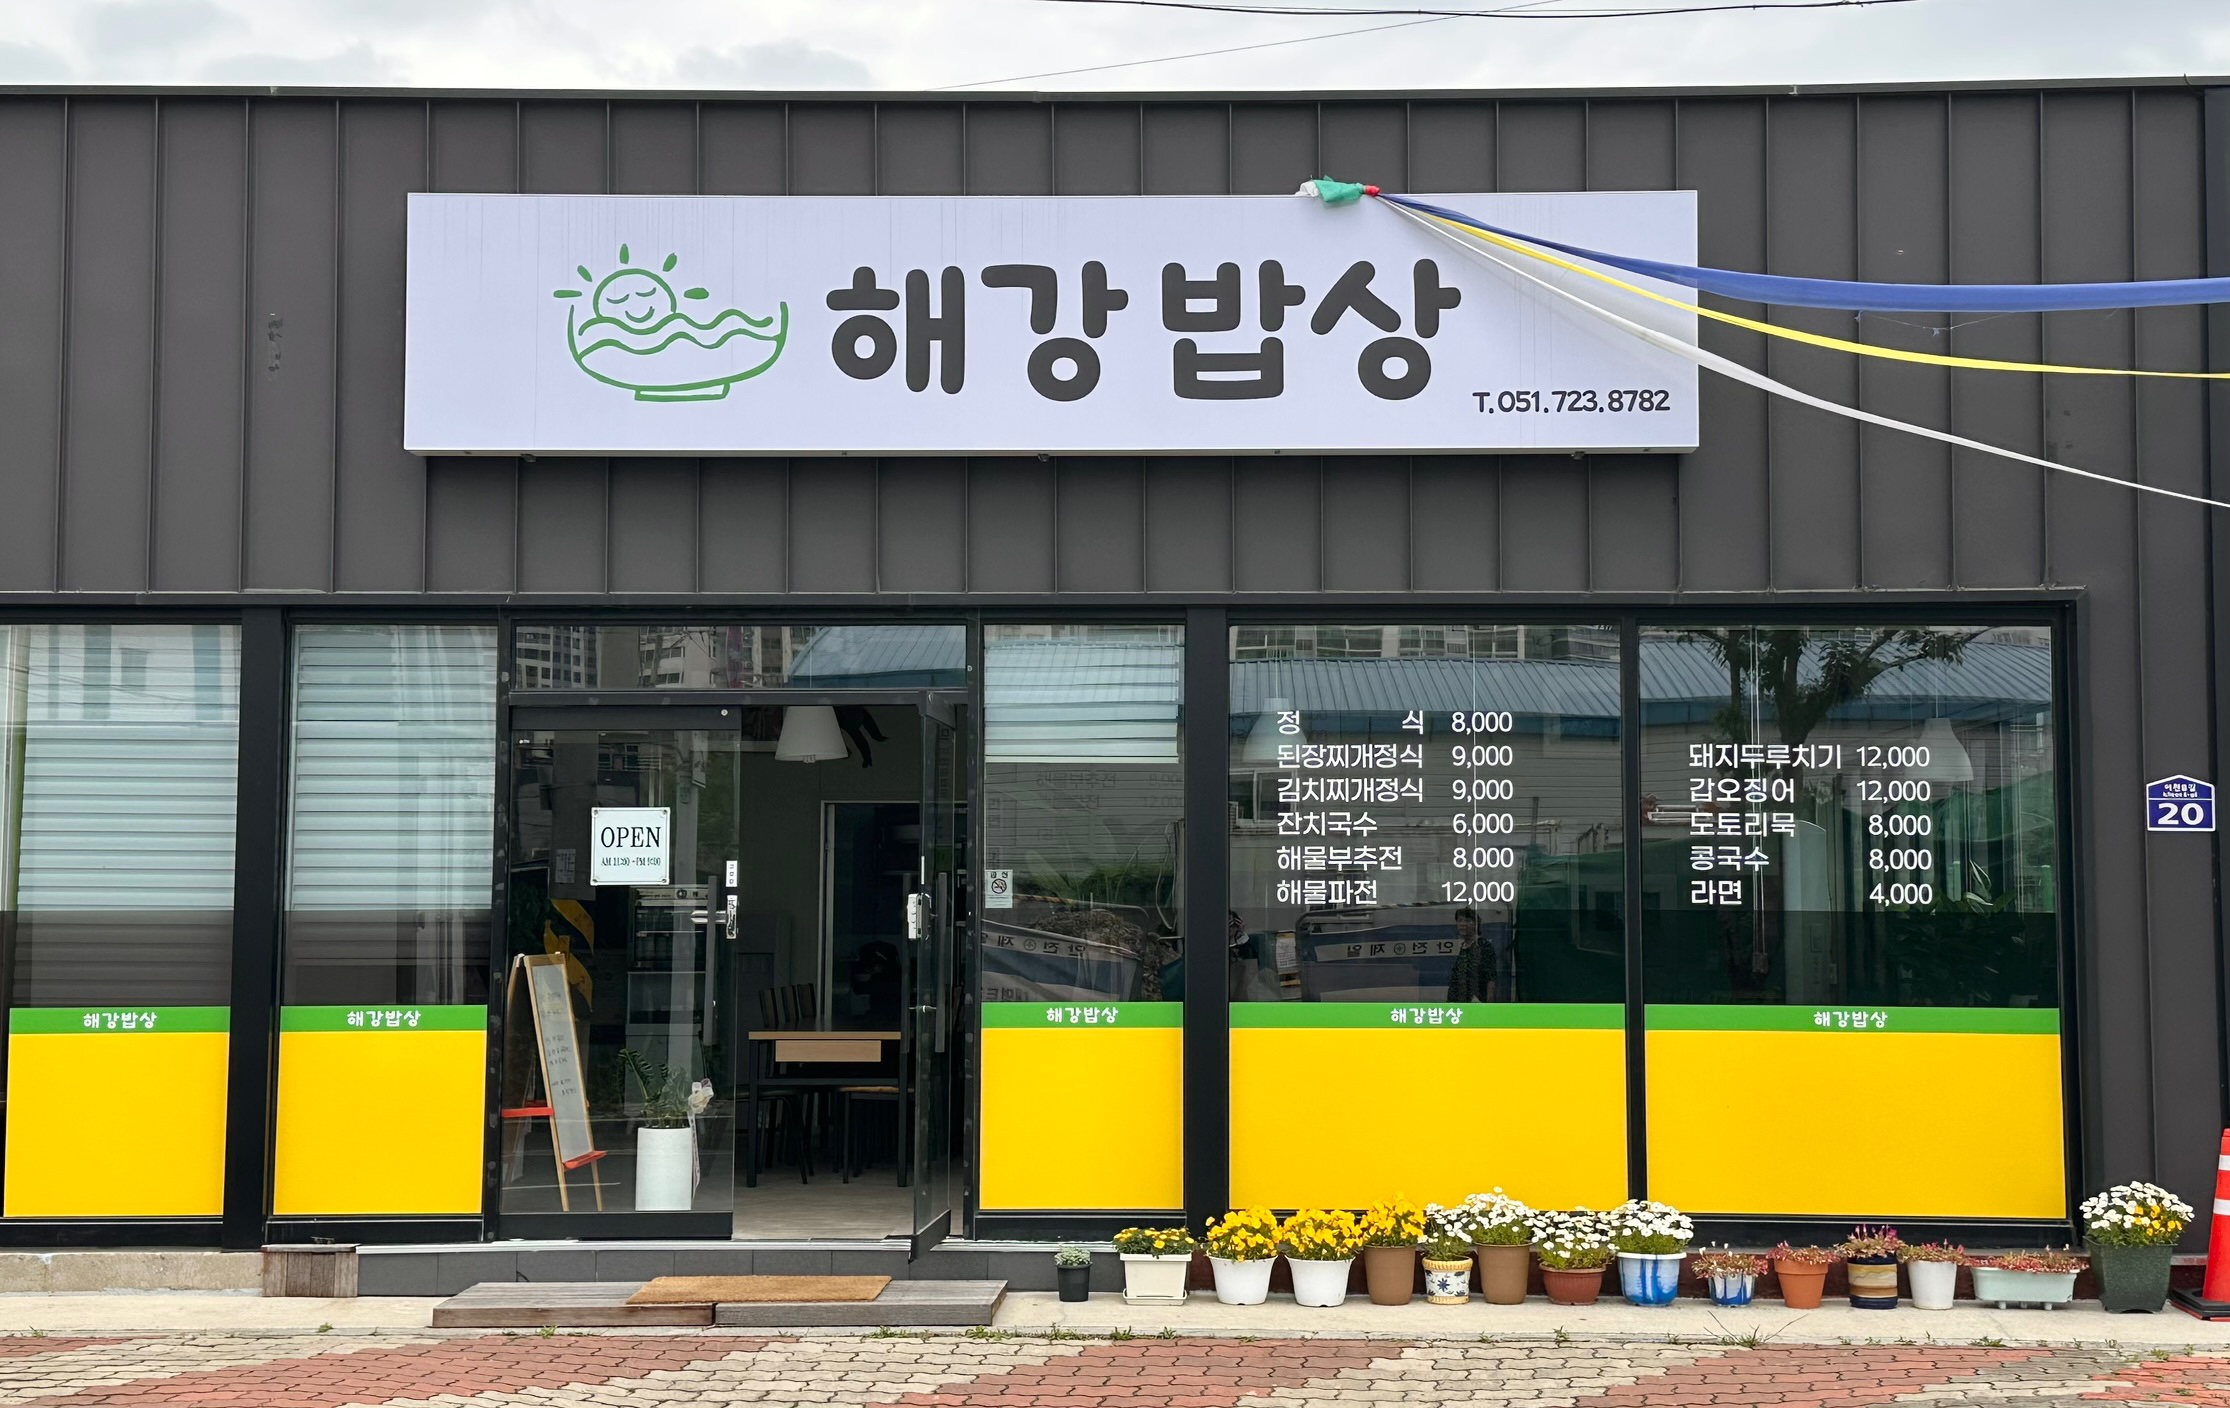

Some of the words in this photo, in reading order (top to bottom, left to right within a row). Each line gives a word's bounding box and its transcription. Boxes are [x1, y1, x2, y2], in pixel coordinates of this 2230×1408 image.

[1472, 389, 1671, 414] T.051.723.8782
[1451, 711, 1513, 734] 8,000
[1276, 743, 1424, 769] 된장찌개정식
[1451, 745, 1513, 768] 9,000
[1688, 743, 1842, 770] 돼지두루치기
[1856, 745, 1931, 769] 12,000
[1276, 777, 1424, 803] 김치찌개정식
[1452, 779, 1514, 803] 9,000
[1689, 777, 1796, 803] 갑오징어
[1856, 780, 1931, 804] 12,000
[1276, 811, 1379, 837] 잔치국수
[1452, 813, 1514, 837] 6,000
[1689, 811, 1797, 838] 도토리묵
[1868, 815, 1932, 838] 8,000
[2157, 802, 2204, 826] 20
[600, 826, 661, 848] OPEN
[1276, 845, 1404, 871] 해물부추전
[1452, 847, 1515, 870] 8,000
[1689, 845, 1771, 872] 콩국수
[1869, 849, 1933, 872] 8,000
[1276, 879, 1379, 905] 해물파전
[1441, 882, 1516, 905] 12,000
[1690, 879, 1743, 905] 라면
[1869, 883, 1933, 907] 4,000
[83, 1010, 158, 1030] 해강밥상
[346, 1009, 422, 1029] 해강밥상
[1046, 1005, 1119, 1025] 해강밥상
[1390, 1006, 1464, 1026] 해강밥상
[1813, 1011, 1889, 1029] 해강밥상
